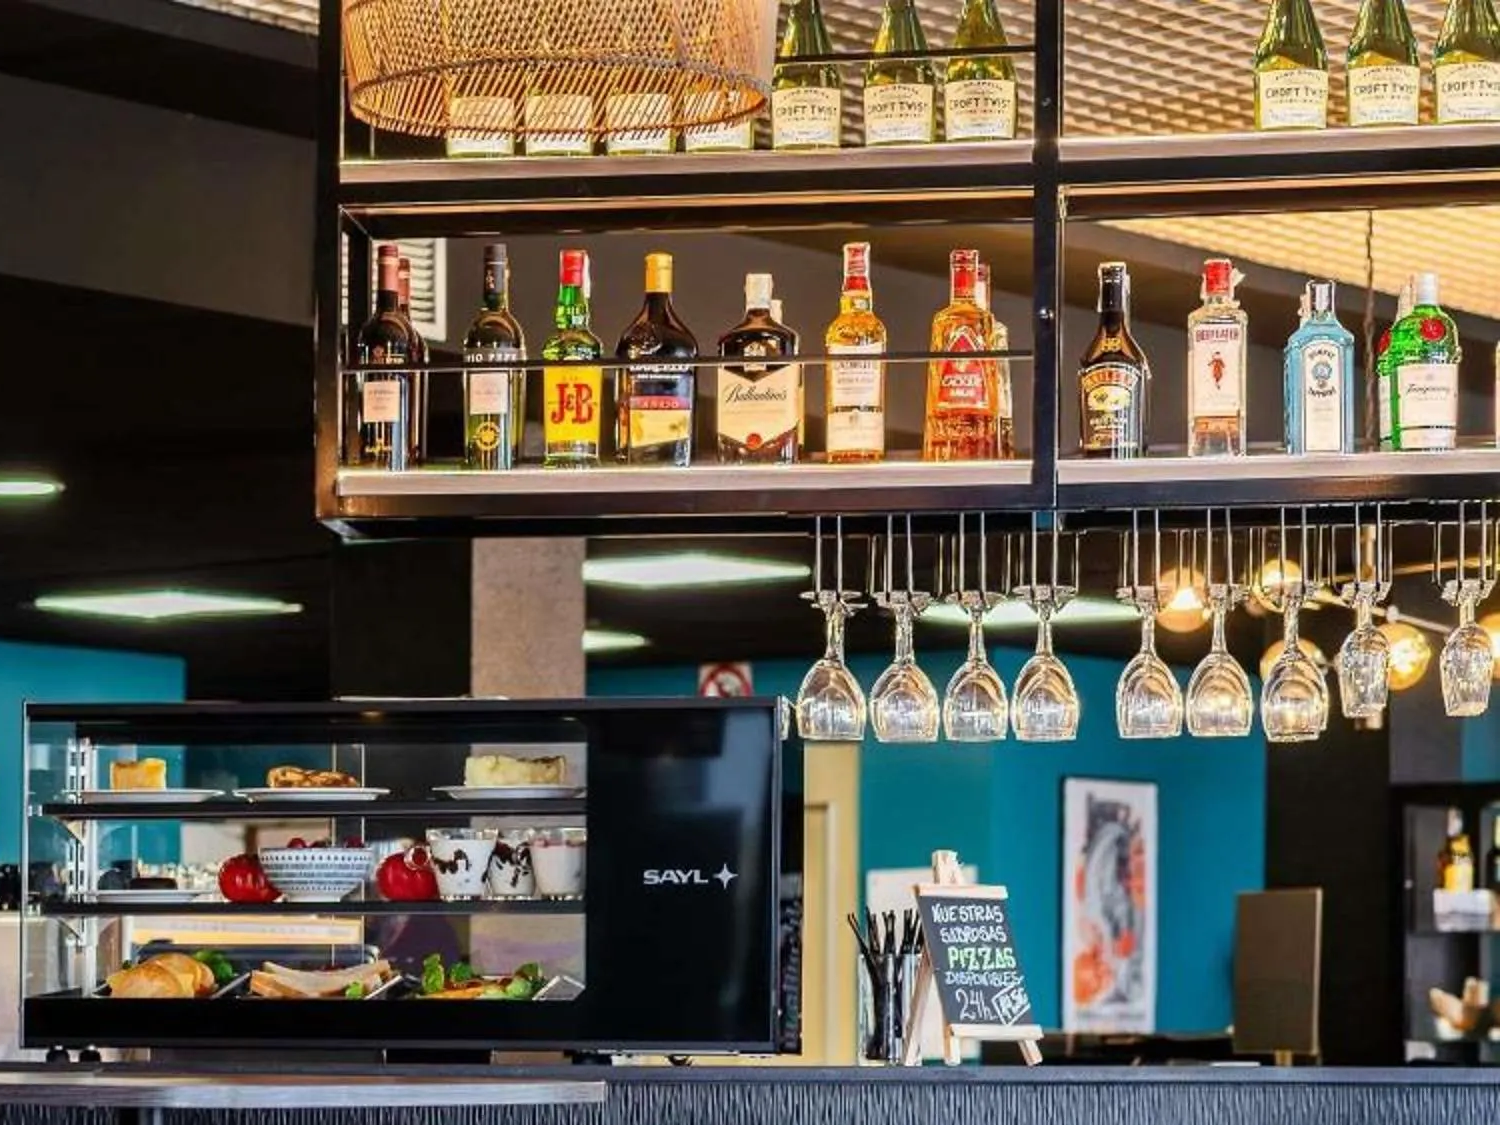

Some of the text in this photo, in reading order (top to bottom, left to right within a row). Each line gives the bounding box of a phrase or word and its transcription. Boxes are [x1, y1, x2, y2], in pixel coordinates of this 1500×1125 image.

[551, 383, 594, 425] J&B
[643, 869, 709, 885] SAYL
[931, 903, 1005, 924] NUESTRAS
[947, 945, 1017, 971] PIZZAS
